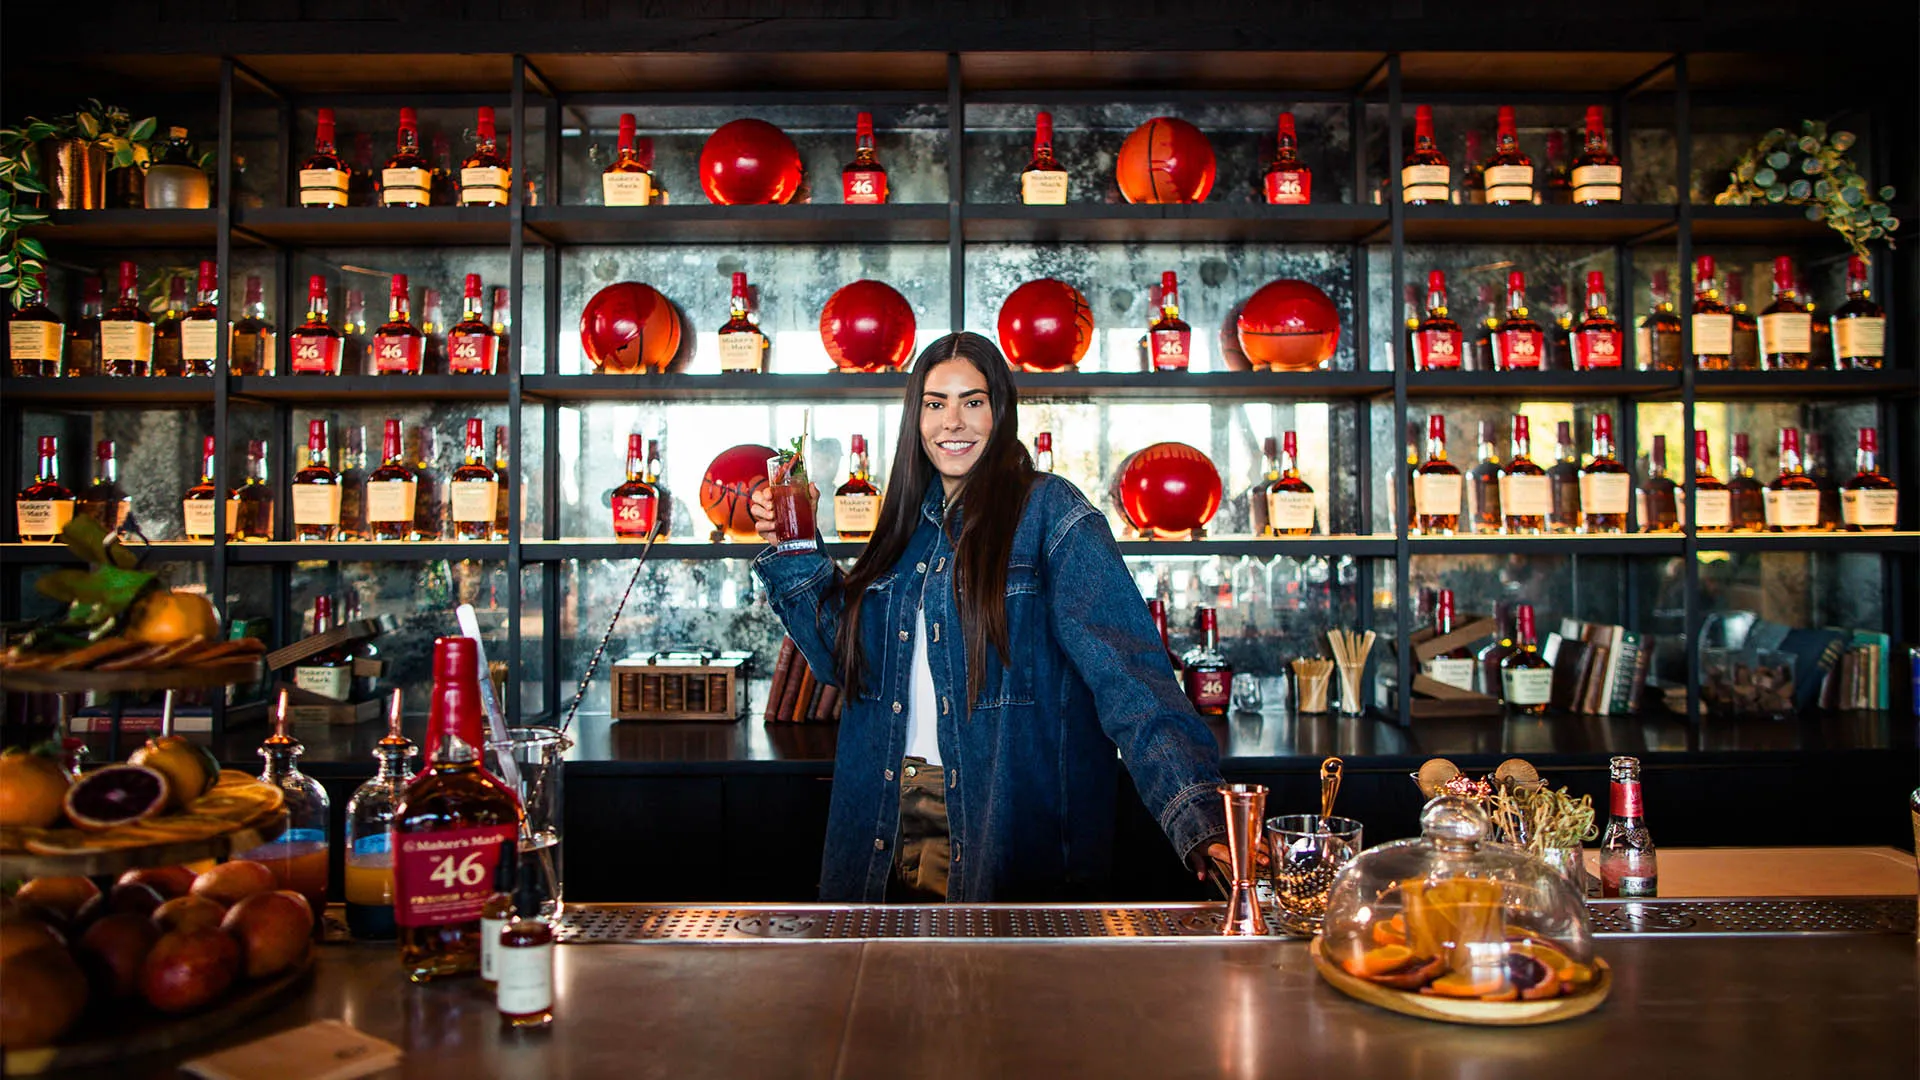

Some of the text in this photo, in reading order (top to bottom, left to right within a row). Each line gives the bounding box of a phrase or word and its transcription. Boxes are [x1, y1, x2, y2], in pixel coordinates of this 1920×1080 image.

[851, 180, 873, 194] 46
[1279, 180, 1302, 194] 46
[297, 344, 319, 359] 46
[381, 344, 402, 359] 46
[455, 344, 476, 358] 46
[1161, 340, 1183, 355] 46
[1433, 340, 1454, 355] 46
[1513, 340, 1535, 355] 46
[1593, 340, 1615, 355] 46
[19, 502, 51, 510] Maker's
[619, 505, 640, 520] 46
[1203, 680, 1223, 694] 46
[416, 837, 469, 851] Maker's
[429, 851, 486, 888] 46
